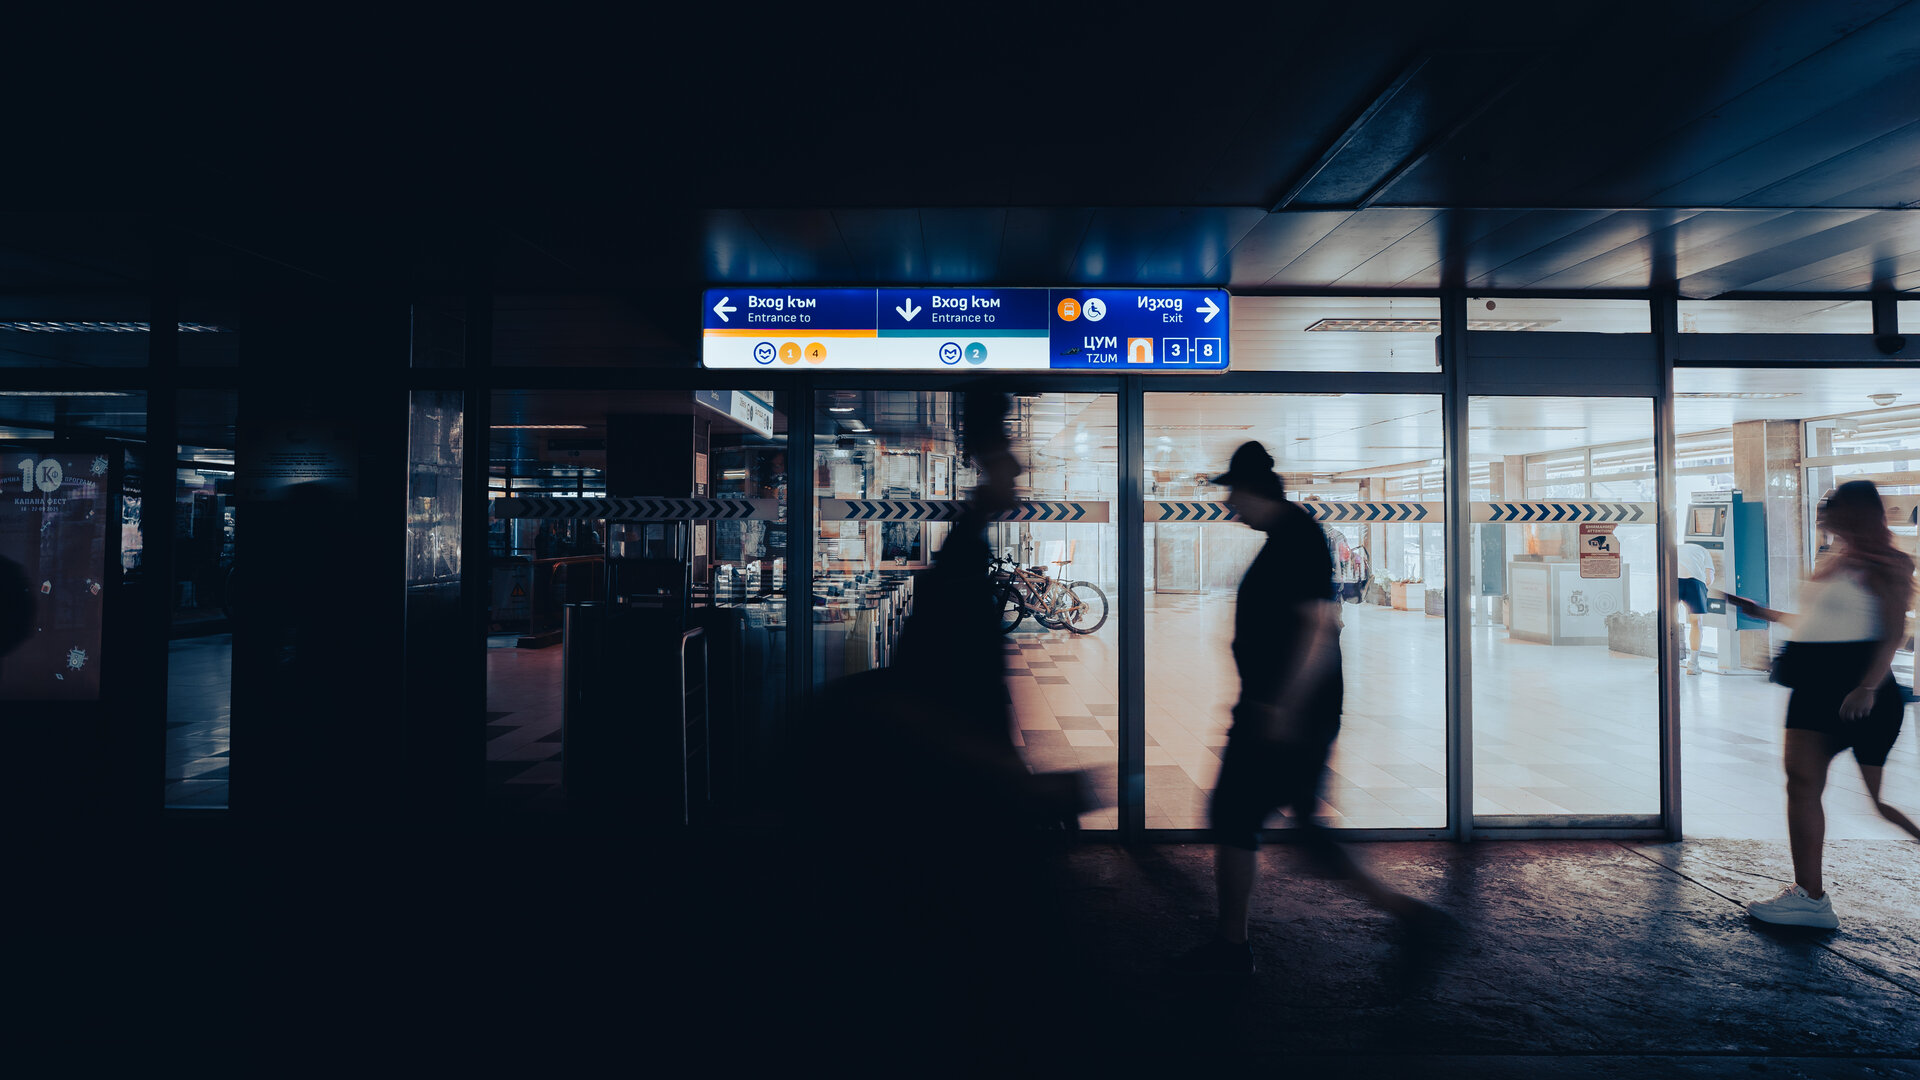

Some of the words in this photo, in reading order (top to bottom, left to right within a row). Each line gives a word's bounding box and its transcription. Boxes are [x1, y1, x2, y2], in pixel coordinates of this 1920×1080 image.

[748, 295, 784, 311] Вход
[787, 295, 816, 308] към
[932, 295, 968, 311] Вход
[971, 295, 1001, 308] към
[1137, 295, 1183, 311] Изход
[748, 312, 797, 323] Entrance
[799, 313, 811, 323] to
[932, 312, 981, 323] Entrance
[984, 313, 995, 323] to
[1162, 313, 1183, 323] Exit
[1084, 336, 1117, 350] ЦУМ
[1086, 353, 1118, 363] TZUM
[18, 458, 63, 492] 10
[47, 497, 67, 506] ФЕСТ
